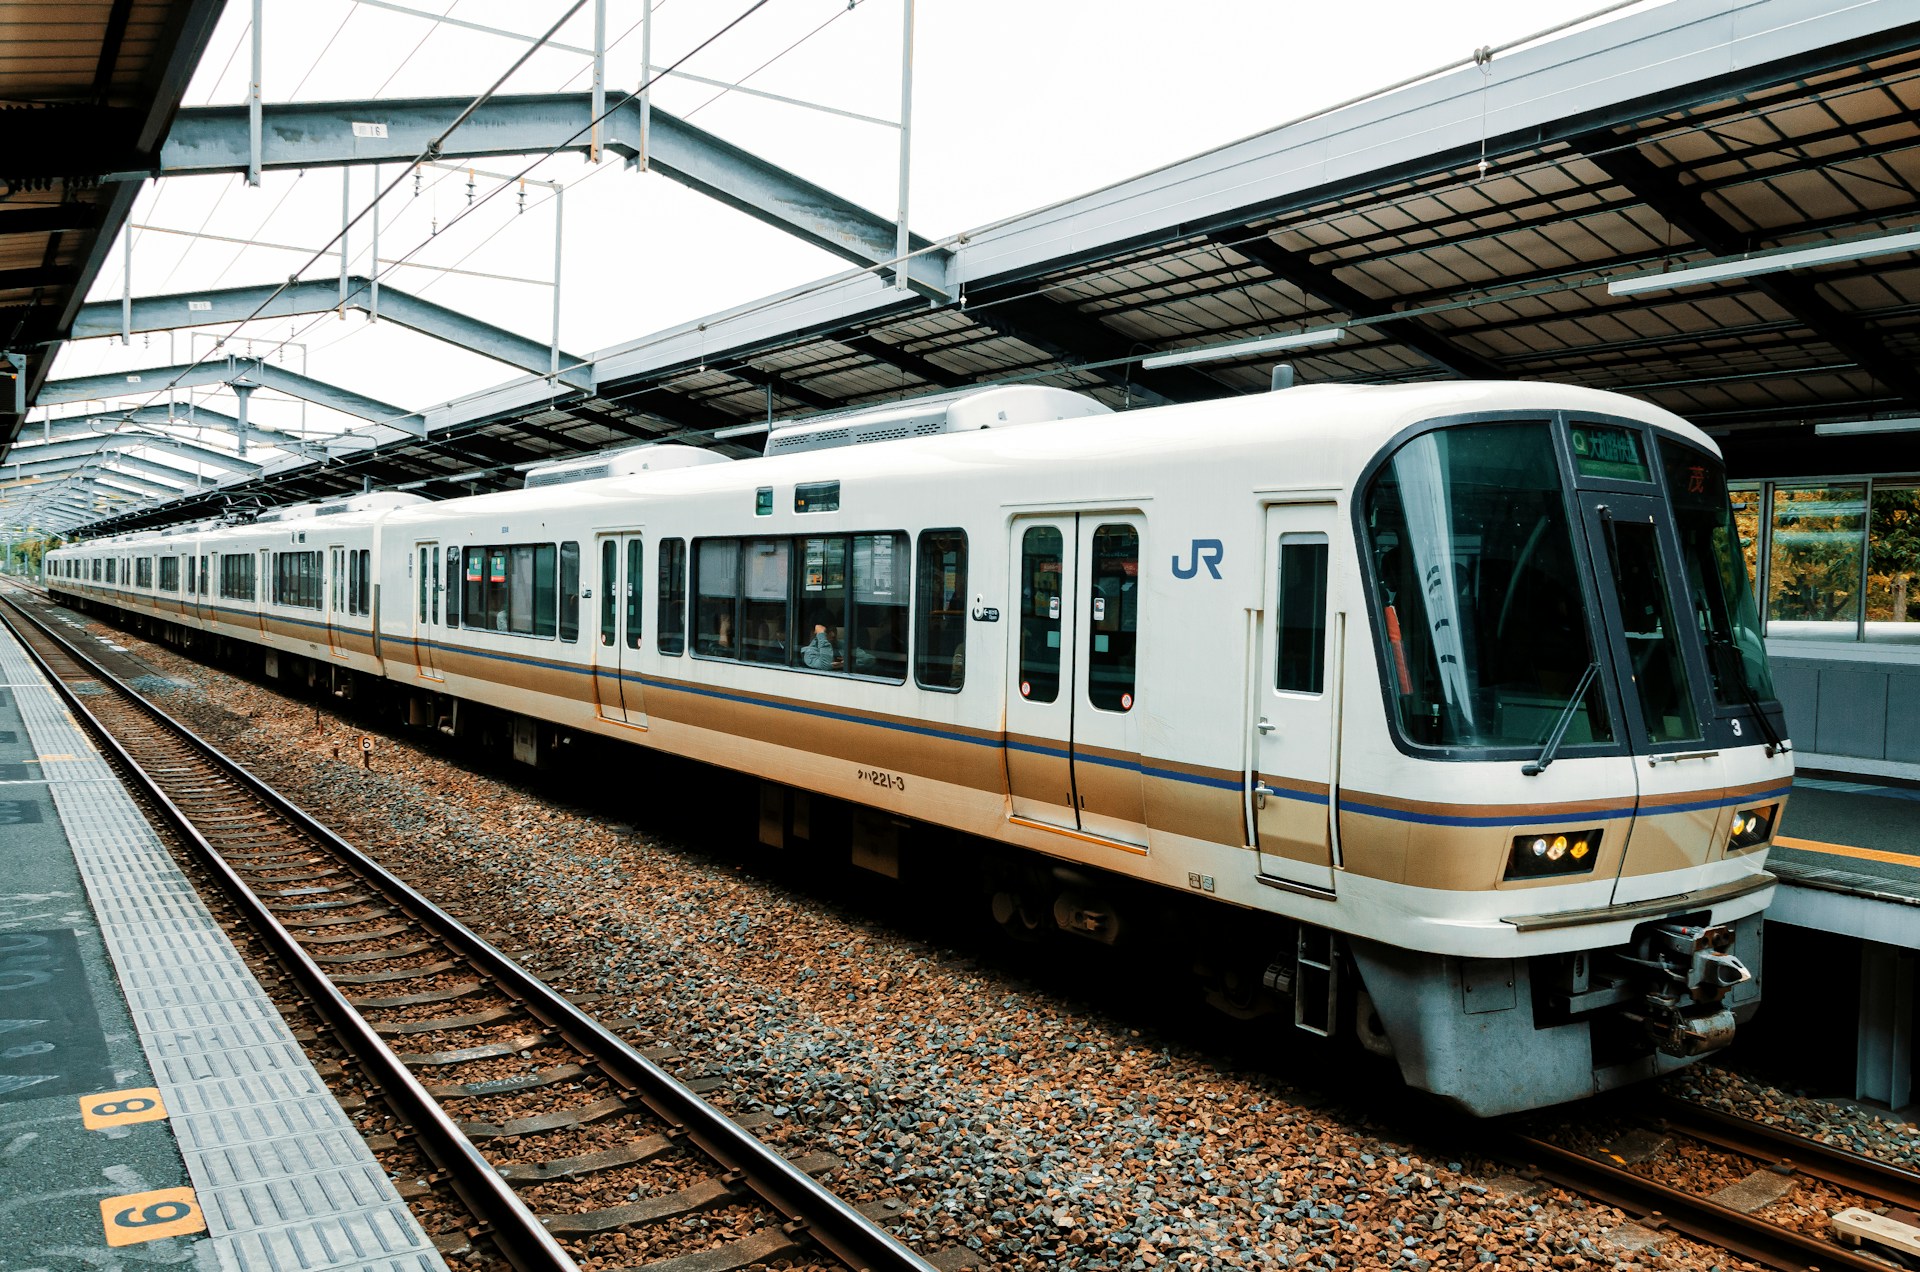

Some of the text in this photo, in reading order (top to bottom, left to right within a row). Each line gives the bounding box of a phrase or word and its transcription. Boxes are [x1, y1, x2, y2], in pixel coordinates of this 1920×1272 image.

[1573, 432, 1586, 452] Q
[1172, 539, 1223, 579] JR
[1731, 719, 1742, 736] 3
[363, 738, 371, 749] 6
[91, 1098, 156, 1116] 8
